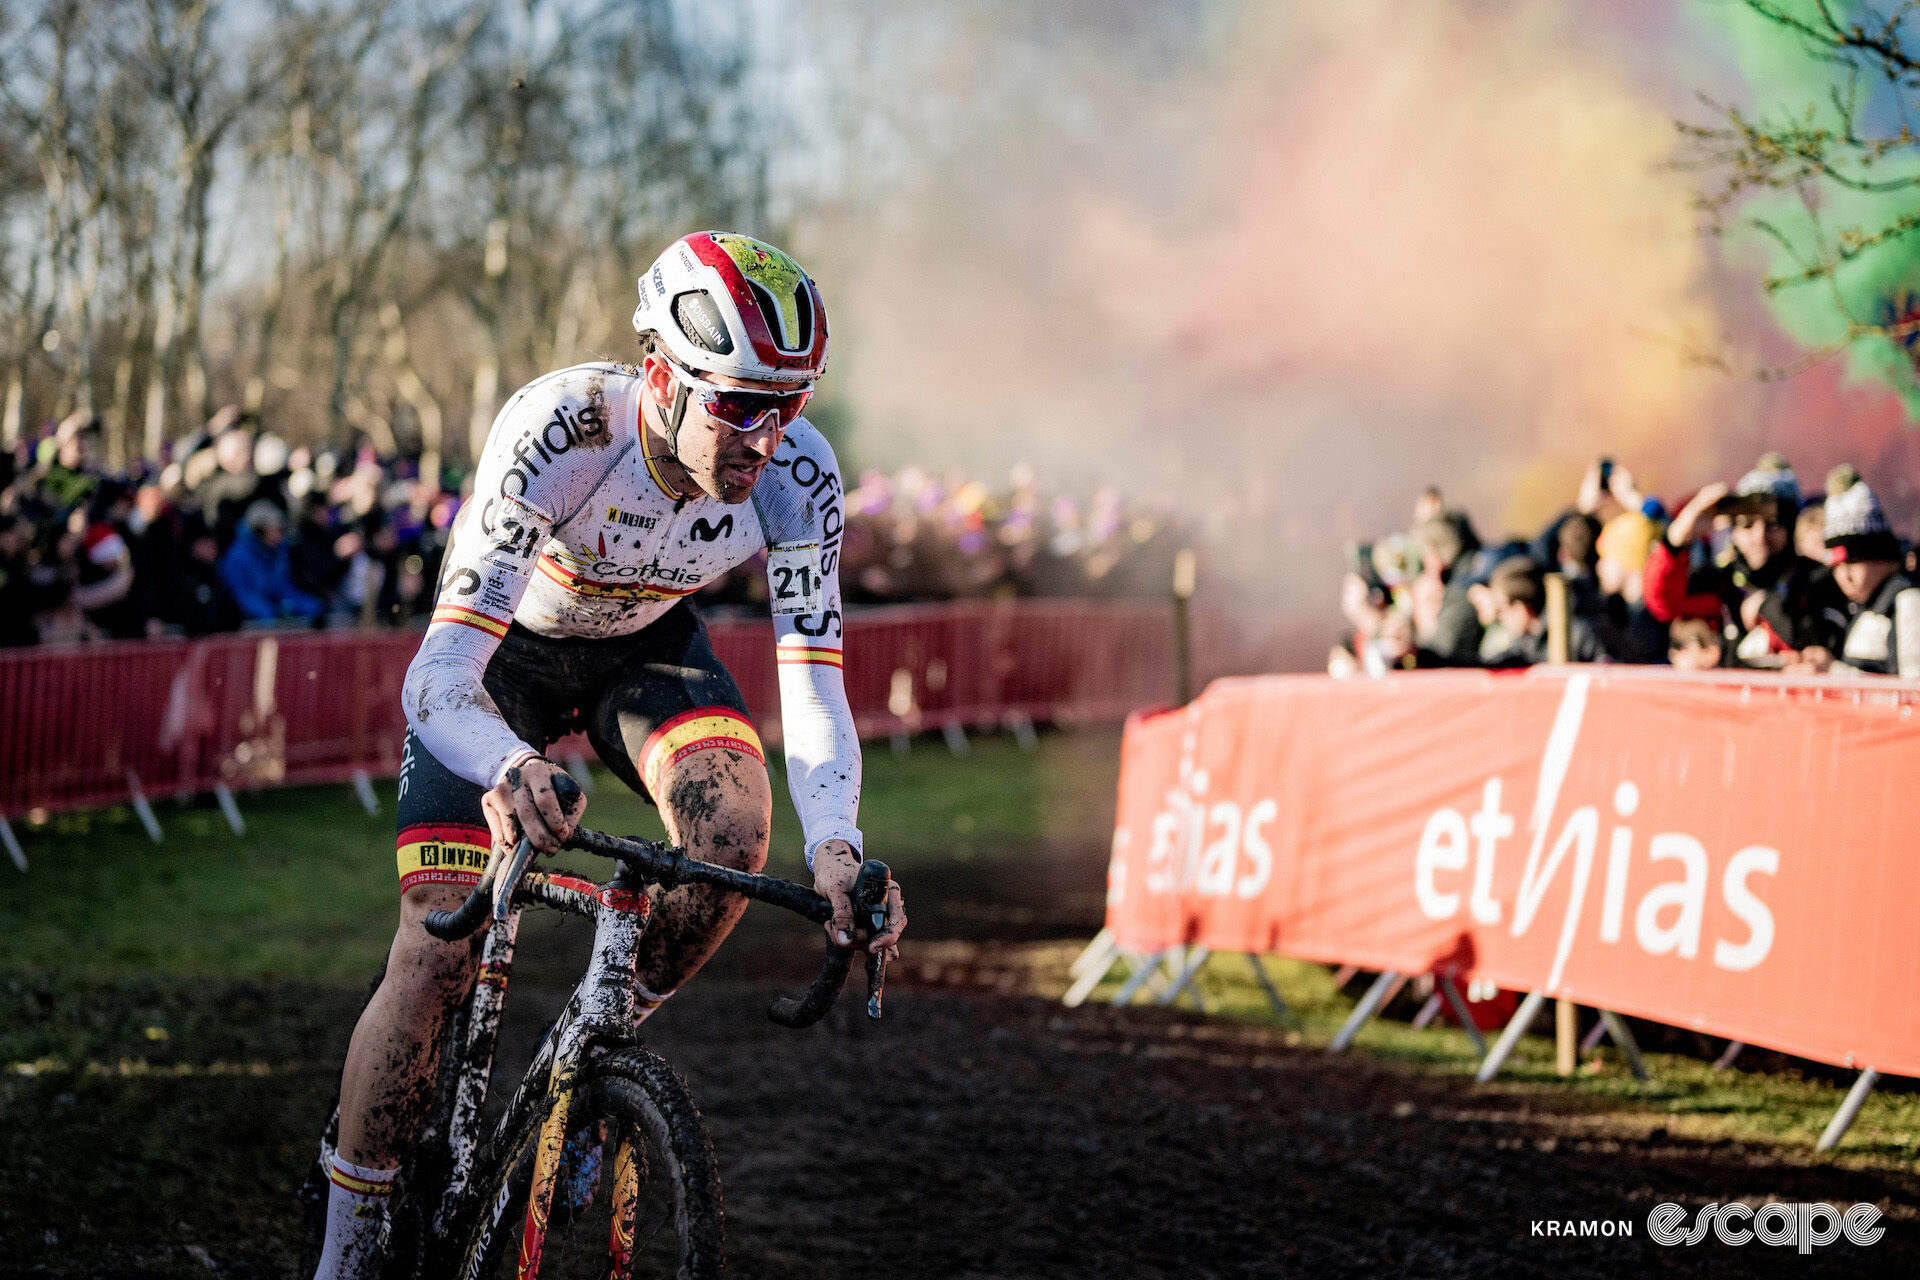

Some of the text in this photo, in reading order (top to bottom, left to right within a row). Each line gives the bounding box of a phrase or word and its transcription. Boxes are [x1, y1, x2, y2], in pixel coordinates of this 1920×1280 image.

[653, 262, 666, 297] LAZER
[482, 405, 603, 535] Cofidis
[771, 434, 842, 577] Cofidis
[494, 519, 540, 559] 21
[783, 544, 796, 553] UCI
[592, 561, 701, 584] Cofidis
[773, 565, 810, 599] 21
[1415, 672, 1780, 993] ethias
[442, 847, 490, 871] INVERS
[493, 1181, 511, 1229] DT
